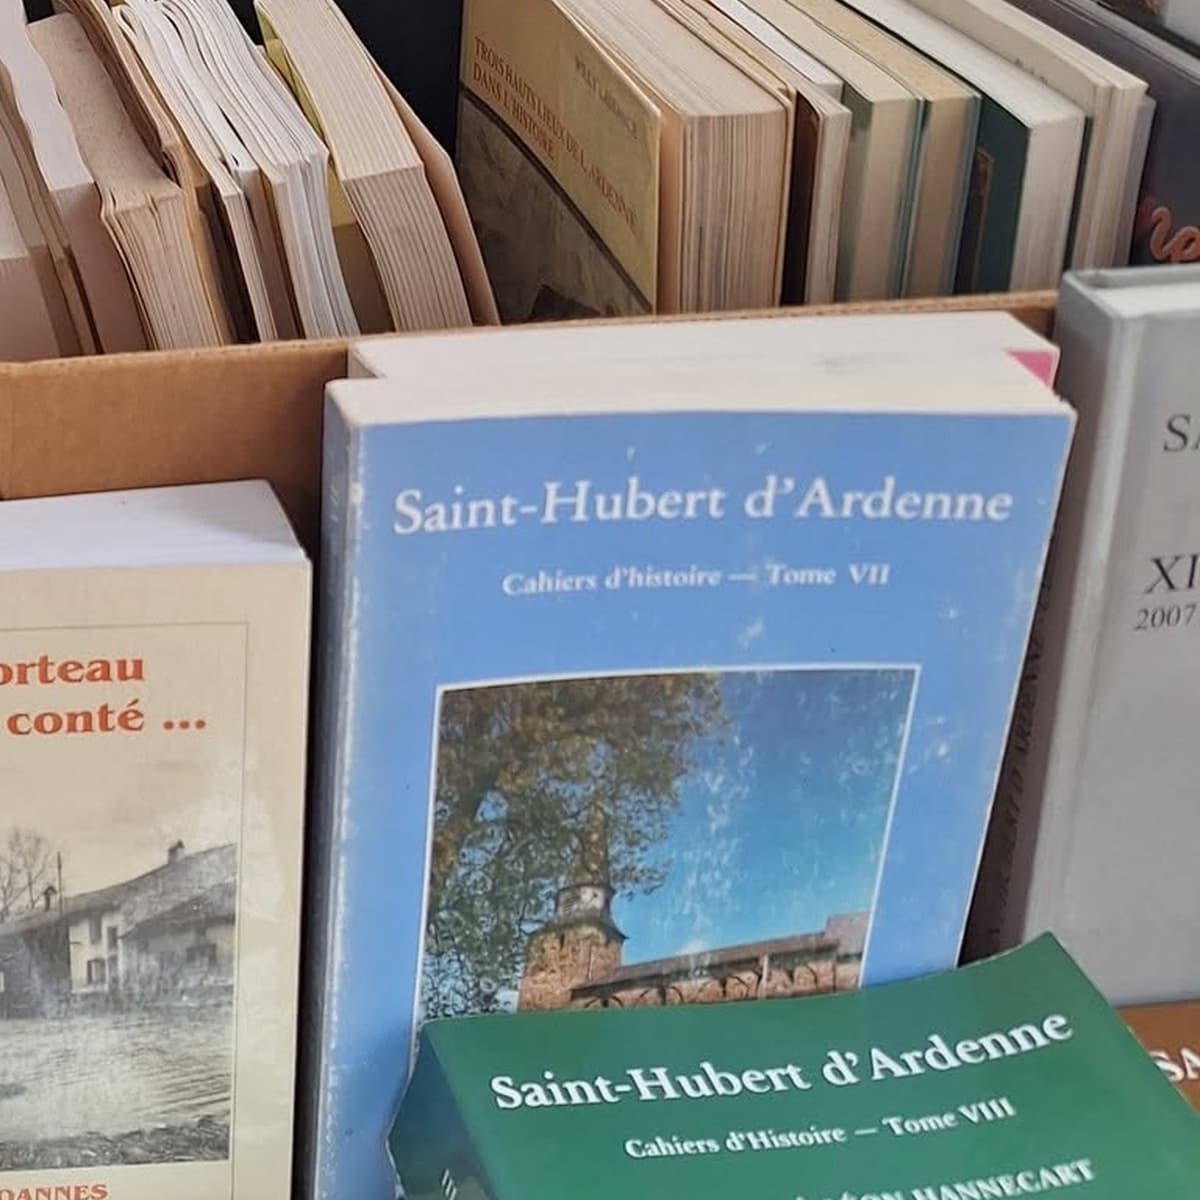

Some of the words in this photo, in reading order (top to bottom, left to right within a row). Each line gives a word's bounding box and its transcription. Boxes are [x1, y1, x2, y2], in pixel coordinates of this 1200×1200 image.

[1163, 413, 1200, 452] S
[393, 476, 725, 536] Saint-Hubert
[744, 475, 1013, 522] d'Ardenne
[501, 569, 598, 596] Cahiers
[604, 565, 722, 591] d'histoire
[765, 563, 837, 586] Tome
[849, 563, 890, 585] VII
[6, 698, 145, 736] conté
[489, 1061, 813, 1110] Saint-Hubert
[821, 1011, 1074, 1088] d'Ardenne
[624, 1135, 721, 1159] Cahiers
[725, 1124, 848, 1153] d'Histoire
[882, 1111, 958, 1137] Tome
[957, 1096, 1017, 1126] VIII
